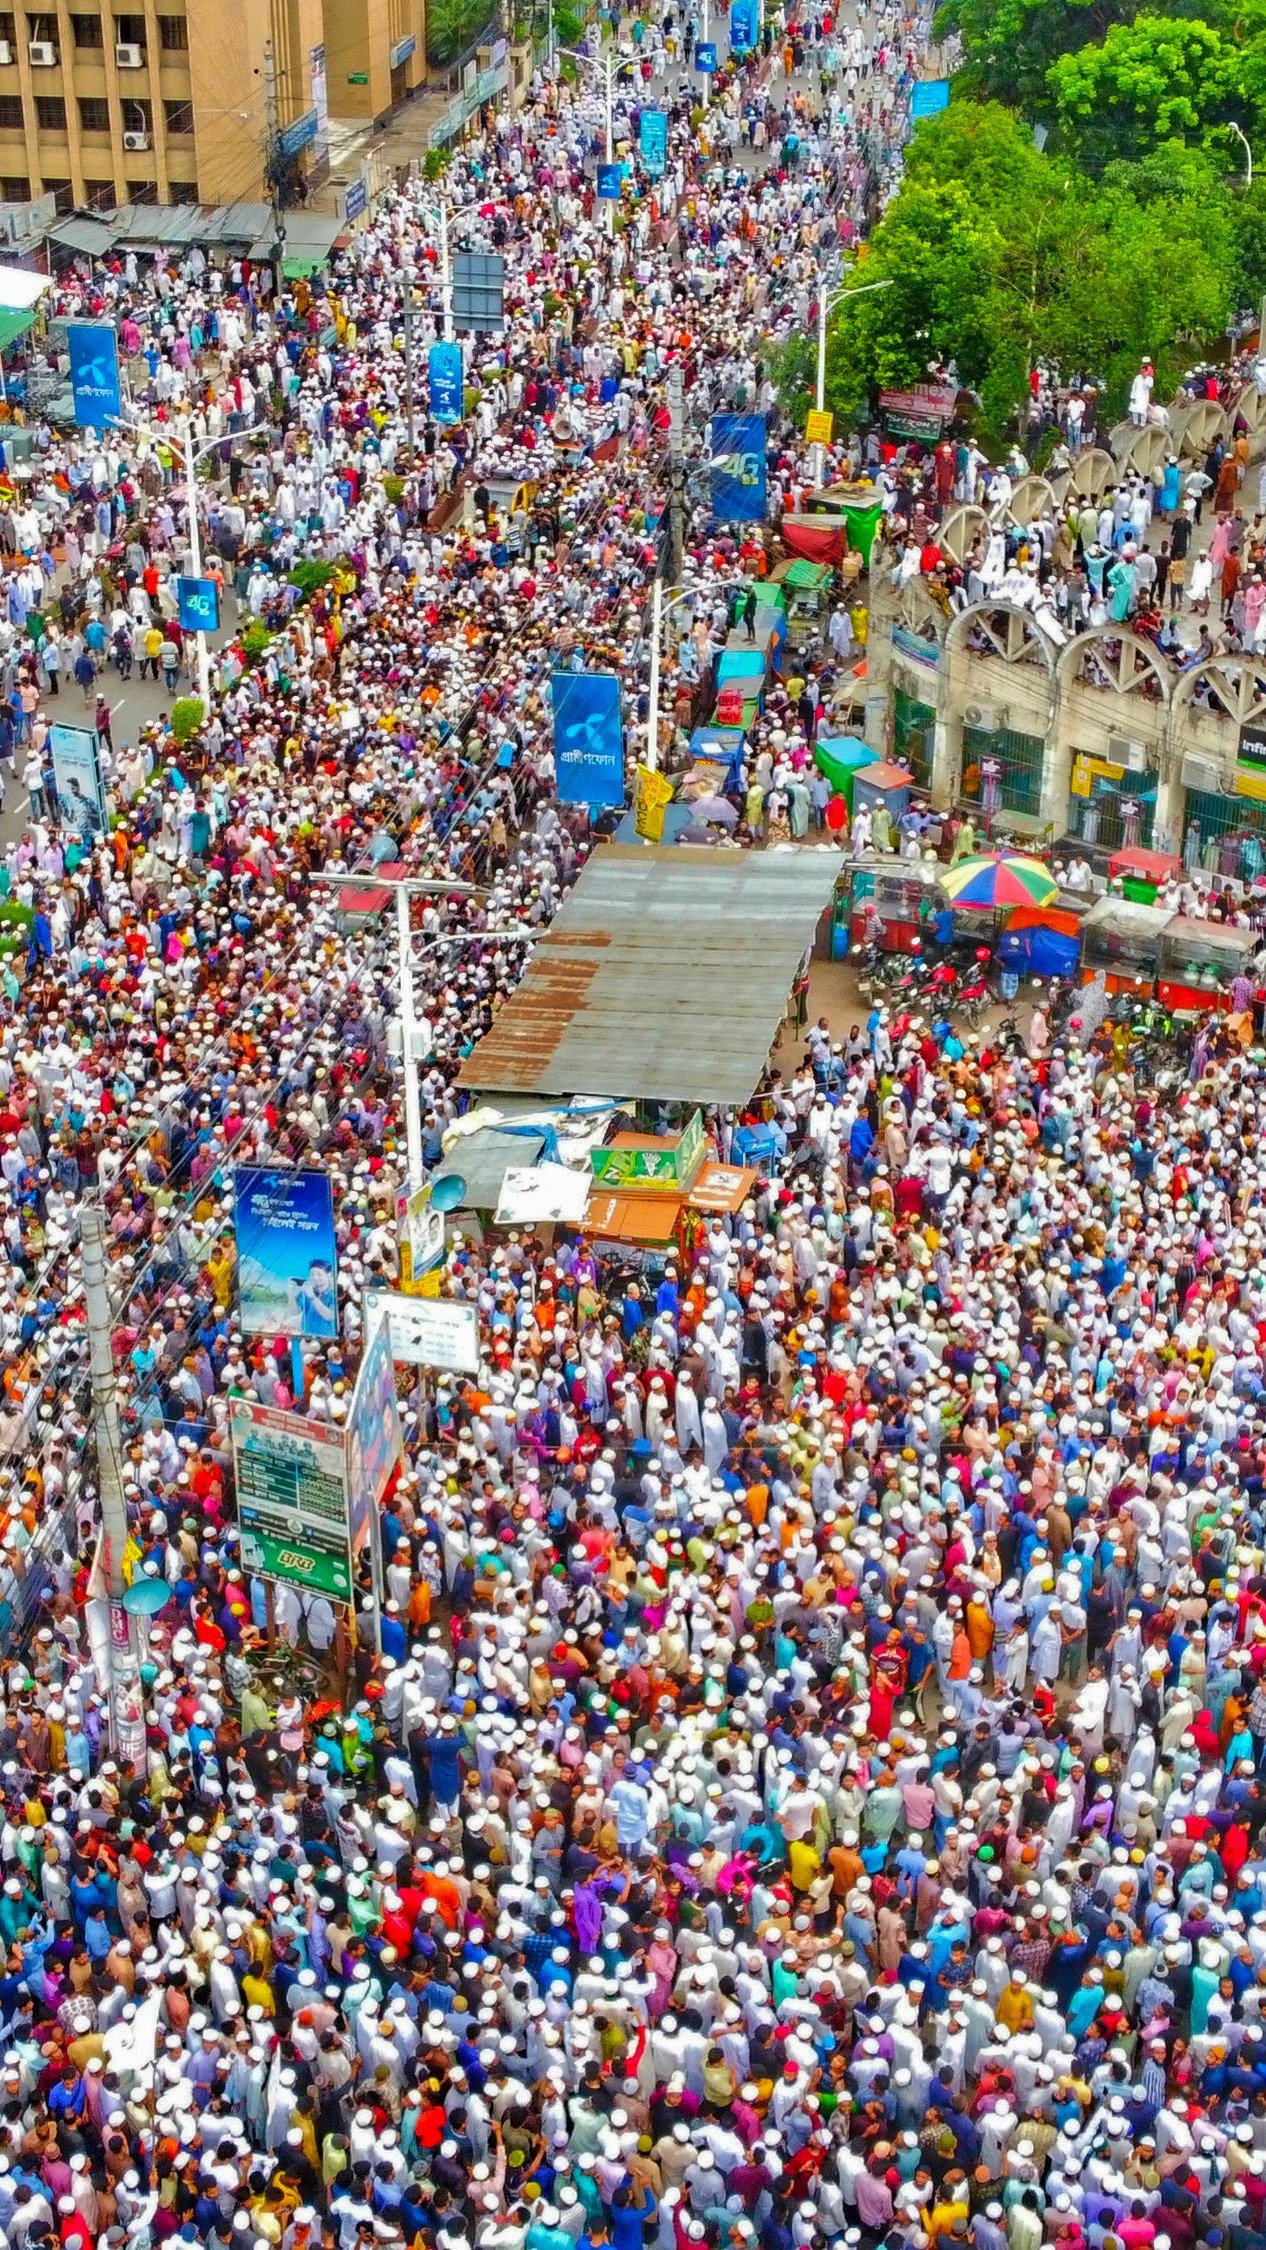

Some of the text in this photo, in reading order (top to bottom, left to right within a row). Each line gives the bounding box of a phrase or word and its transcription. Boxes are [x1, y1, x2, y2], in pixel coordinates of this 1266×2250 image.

[721, 452, 759, 479] 4G
[186, 594, 209, 611] 4G
[560, 748, 616, 766] গ্রামীণফোন
[279, 1549, 316, 1573] BRB
